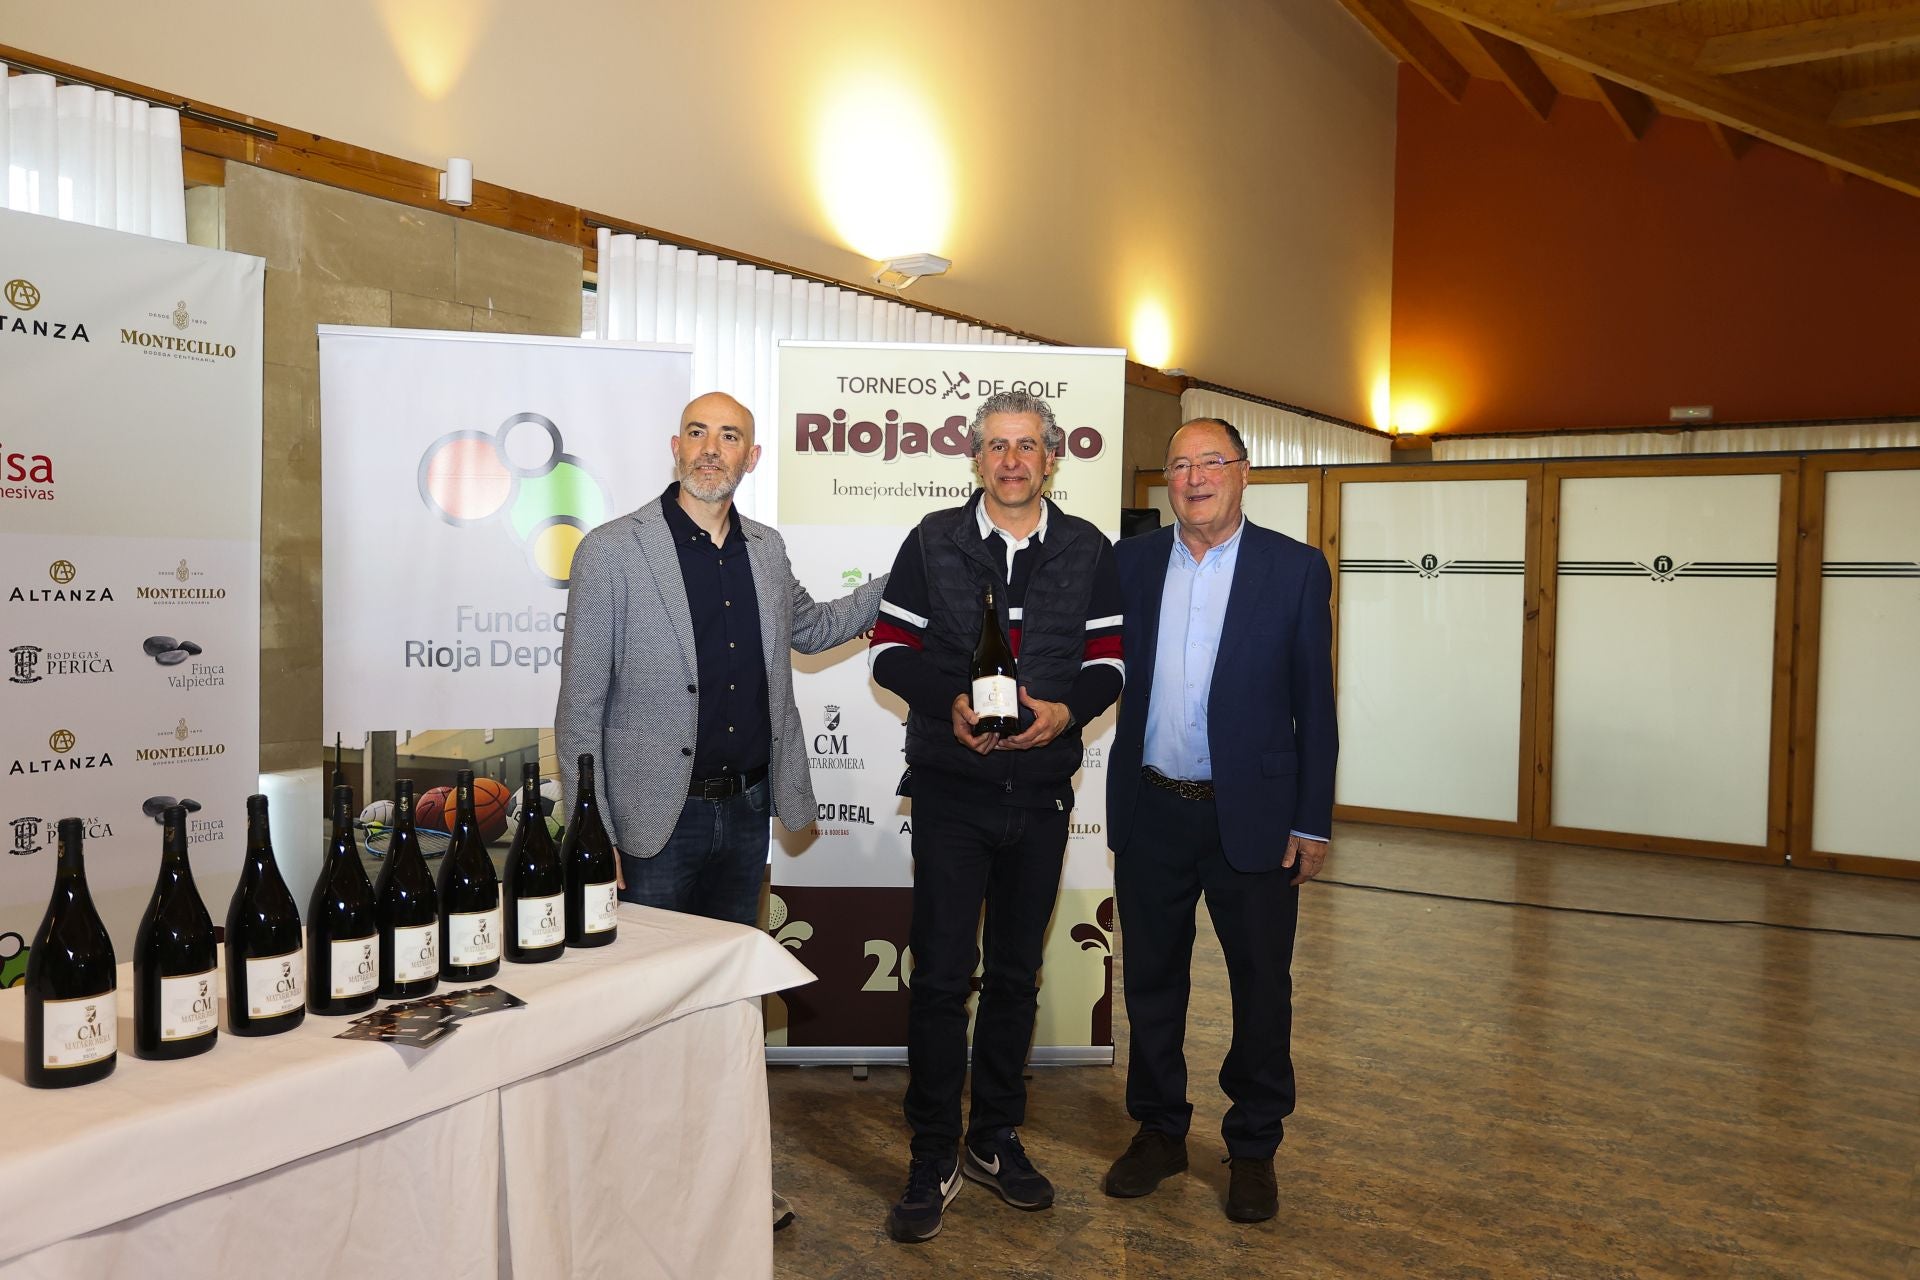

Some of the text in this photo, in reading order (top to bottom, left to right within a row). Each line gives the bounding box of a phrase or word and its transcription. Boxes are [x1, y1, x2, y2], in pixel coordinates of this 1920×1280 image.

[120, 328, 236, 359] MONTECILLO
[837, 376, 937, 396] TORNEOS
[978, 380, 1068, 398] DE GOLF
[9, 587, 114, 602] ALTANZA
[136, 587, 226, 599] MONTECILLO
[47, 651, 100, 660] BODEGAS
[405, 639, 481, 672] Rioja
[46, 659, 115, 675] PERICA
[192, 663, 225, 675] Finca
[168, 675, 225, 691] Valpiedra
[136, 743, 226, 761] MONTECILLO
[814, 734, 849, 755] CM
[9, 753, 114, 775] ALTANZA
[838, 804, 875, 826] REAL
[191, 819, 224, 832] Finca
[540, 916, 556, 929] CM
[473, 932, 490, 946] CM
[420, 946, 436, 960] CM
[358, 960, 374, 974] CM
[276, 977, 296, 993] CM
[192, 997, 211, 1013] CM
[77, 1022, 102, 1041] CM
